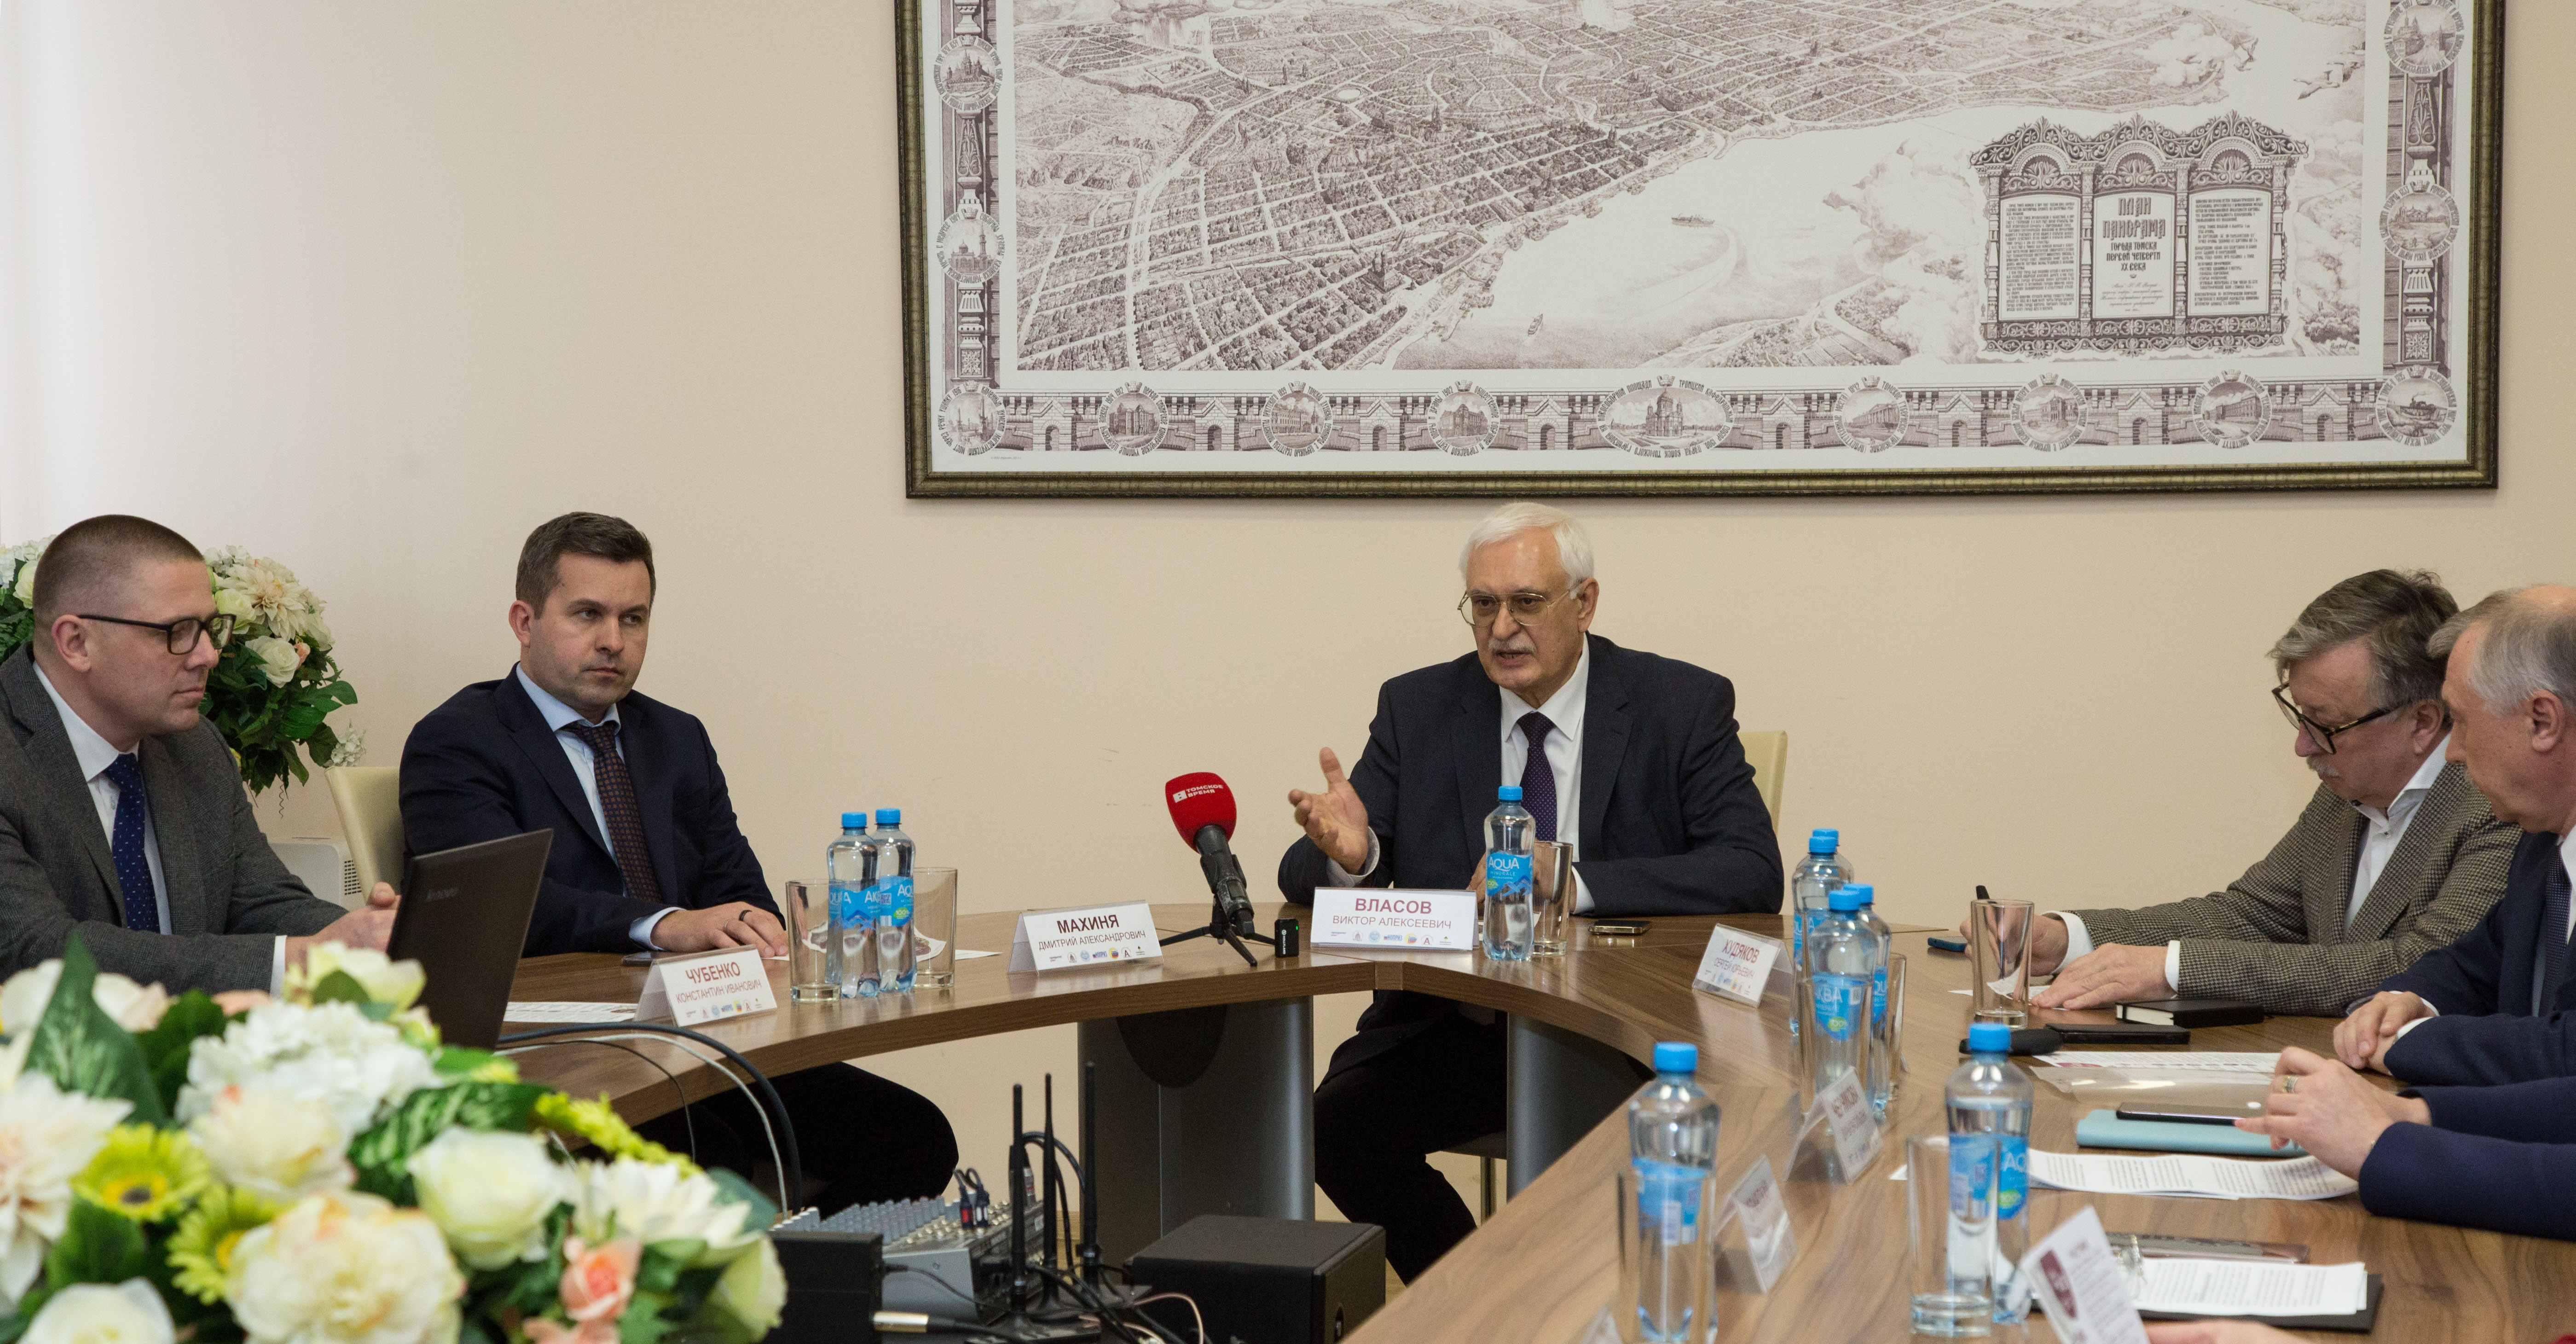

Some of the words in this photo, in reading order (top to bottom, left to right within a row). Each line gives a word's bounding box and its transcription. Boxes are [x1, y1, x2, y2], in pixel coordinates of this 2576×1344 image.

[2119, 197, 2151, 217] ПЛАН
[948, 213, 960, 224] 1904
[979, 213, 1000, 232] СОБОРНАЯ
[2103, 219, 2165, 240] ПАНОРАМА
[2111, 242, 2132, 252] ГОРОДА
[2133, 242, 2157, 251] ТОМСКА
[937, 252, 949, 269] МЕЧЕТЬ
[2107, 252, 2130, 261] ПЕРВОЙ
[2132, 251, 2160, 261] ЧЕТВЕРТИ
[2130, 262, 2146, 271] ВЕКА
[1627, 380, 1652, 392] ПЛОЩАДИ
[1679, 379, 1704, 392] ТРОИЦКИЙ
[1846, 381, 1860, 394] 1842
[2206, 375, 2220, 387] 1900
[951, 386, 961, 396] 1916
[1113, 386, 1124, 396] 1912
[1142, 386, 1158, 400] ПЕРВОЕ
[1276, 387, 1287, 396] 1899
[1306, 386, 1324, 401] ТОМСКАЯ
[1441, 385, 1453, 397] 1902
[1881, 381, 1903, 399] ТОМСКОЕ
[1104, 393, 1115, 404] 1904
[1429, 395, 1443, 414] ДРАМЫ
[1473, 385, 1499, 417] ОБЩЕСТВЕННОЕ
[1598, 388, 1626, 421] НОВОСОБОРНОЙ
[1705, 388, 1733, 422] КАФЕДРАЛЬНЫЙ
[1155, 399, 1168, 424] СИБИРСКОЕ
[938, 415, 946, 430] РЕЧКУ
[1599, 424, 1608, 432] НА
[1428, 423, 1439, 440] ОПЕРЫ
[1483, 421, 1499, 446] СОБРАНИЕ
[1717, 425, 1730, 440] СОБОР
[941, 431, 955, 447] ЧЕРЕЗ
[1141, 426, 1167, 455] КОММЕРЧЕСКОЕ
[1436, 438, 1450, 452] ТЕАТР
[1606, 433, 1632, 452] ГАРНИЗОНА
[953, 444, 966, 454] МОСТ
[1118, 446, 1140, 456] УЧИЛИЩЕ
[1294, 445, 1316, 456] ЦЕРКОВЬЮ
[1451, 446, 1479, 456] ГОРОДСКОЙ
[1635, 447, 1661, 458] ТОМСКОГО
[1685, 445, 1701, 456] ПАРАД
[1186, 784, 1223, 793] ТОМСКОЕ
[1188, 789, 1215, 798] ВРЕМЯ
[1488, 857, 1519, 871] AQUA
[1355, 898, 1432, 914] ВЛАСОВ
[1057, 915, 1119, 933] МАХИНЯ
[1333, 915, 1376, 925] ВИКТОР
[1378, 919, 1451, 929] АЛЕКСЕЕВИЧ
[1039, 936, 1078, 951] ДМИТРИЙ
[1079, 930, 1146, 945] АЛЕКСАНДРОВИЧ
[1722, 938, 1760, 963] ХУДЯКОВ
[685, 962, 741, 984] ЧУБЕНКО
[1714, 957, 1732, 971] СЕРГЕЙ
[1732, 964, 1755, 979] ЮРЬЕВИЧ
[676, 986, 724, 1003] КОНСТАНТИН
[726, 979, 762, 994] ИВАНОВИЧ
